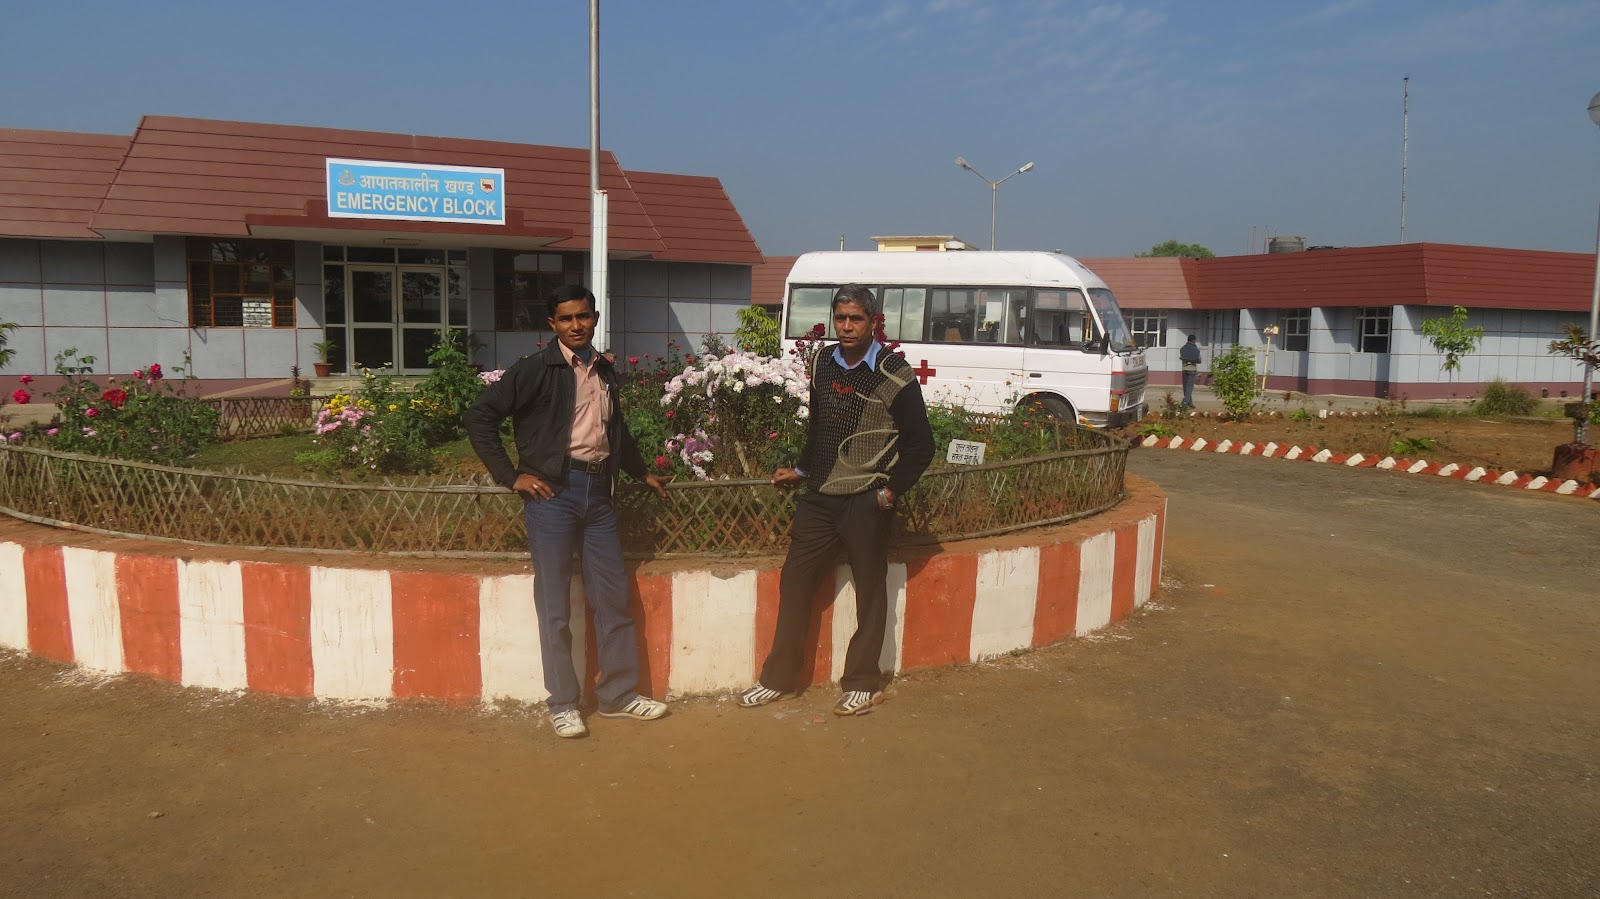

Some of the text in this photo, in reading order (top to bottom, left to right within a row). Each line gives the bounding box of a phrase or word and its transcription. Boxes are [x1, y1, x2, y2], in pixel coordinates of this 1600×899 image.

[359, 172, 475, 195] आपातकालीन खण्ड
[336, 191, 497, 216] EMERGENCY BLOCK
